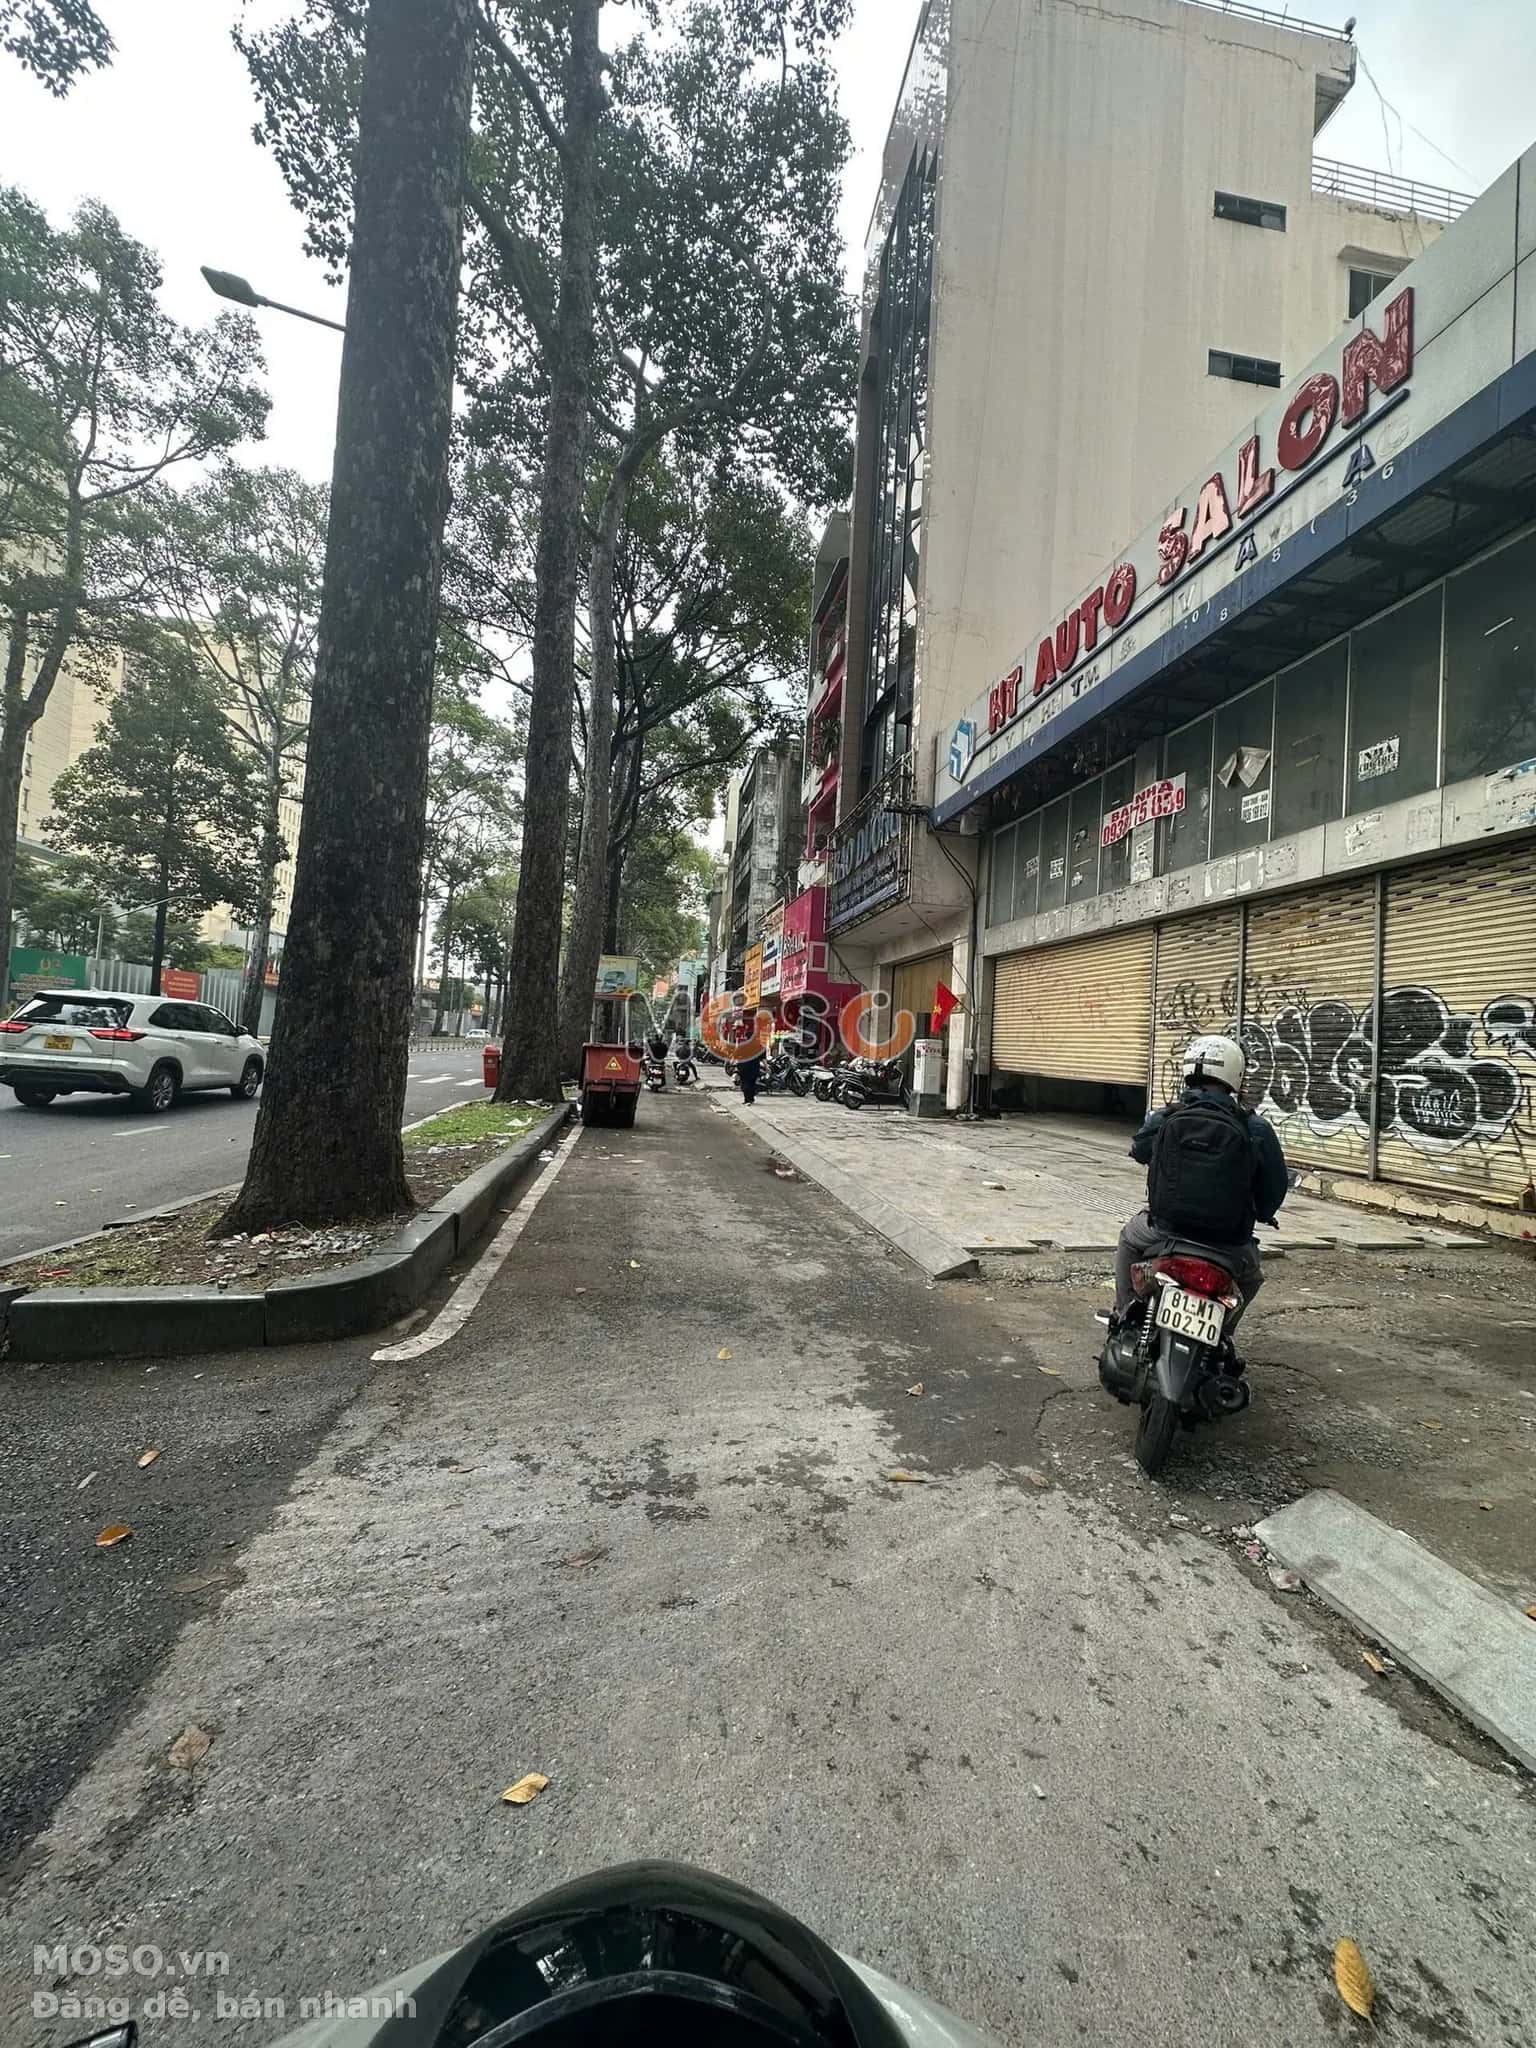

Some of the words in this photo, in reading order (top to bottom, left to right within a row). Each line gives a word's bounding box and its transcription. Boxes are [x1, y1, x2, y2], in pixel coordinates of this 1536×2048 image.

[1033, 561, 1137, 697] AUTO
[1157, 286, 1415, 586] SALON
[1161, 1308, 1217, 1341] 002.70
